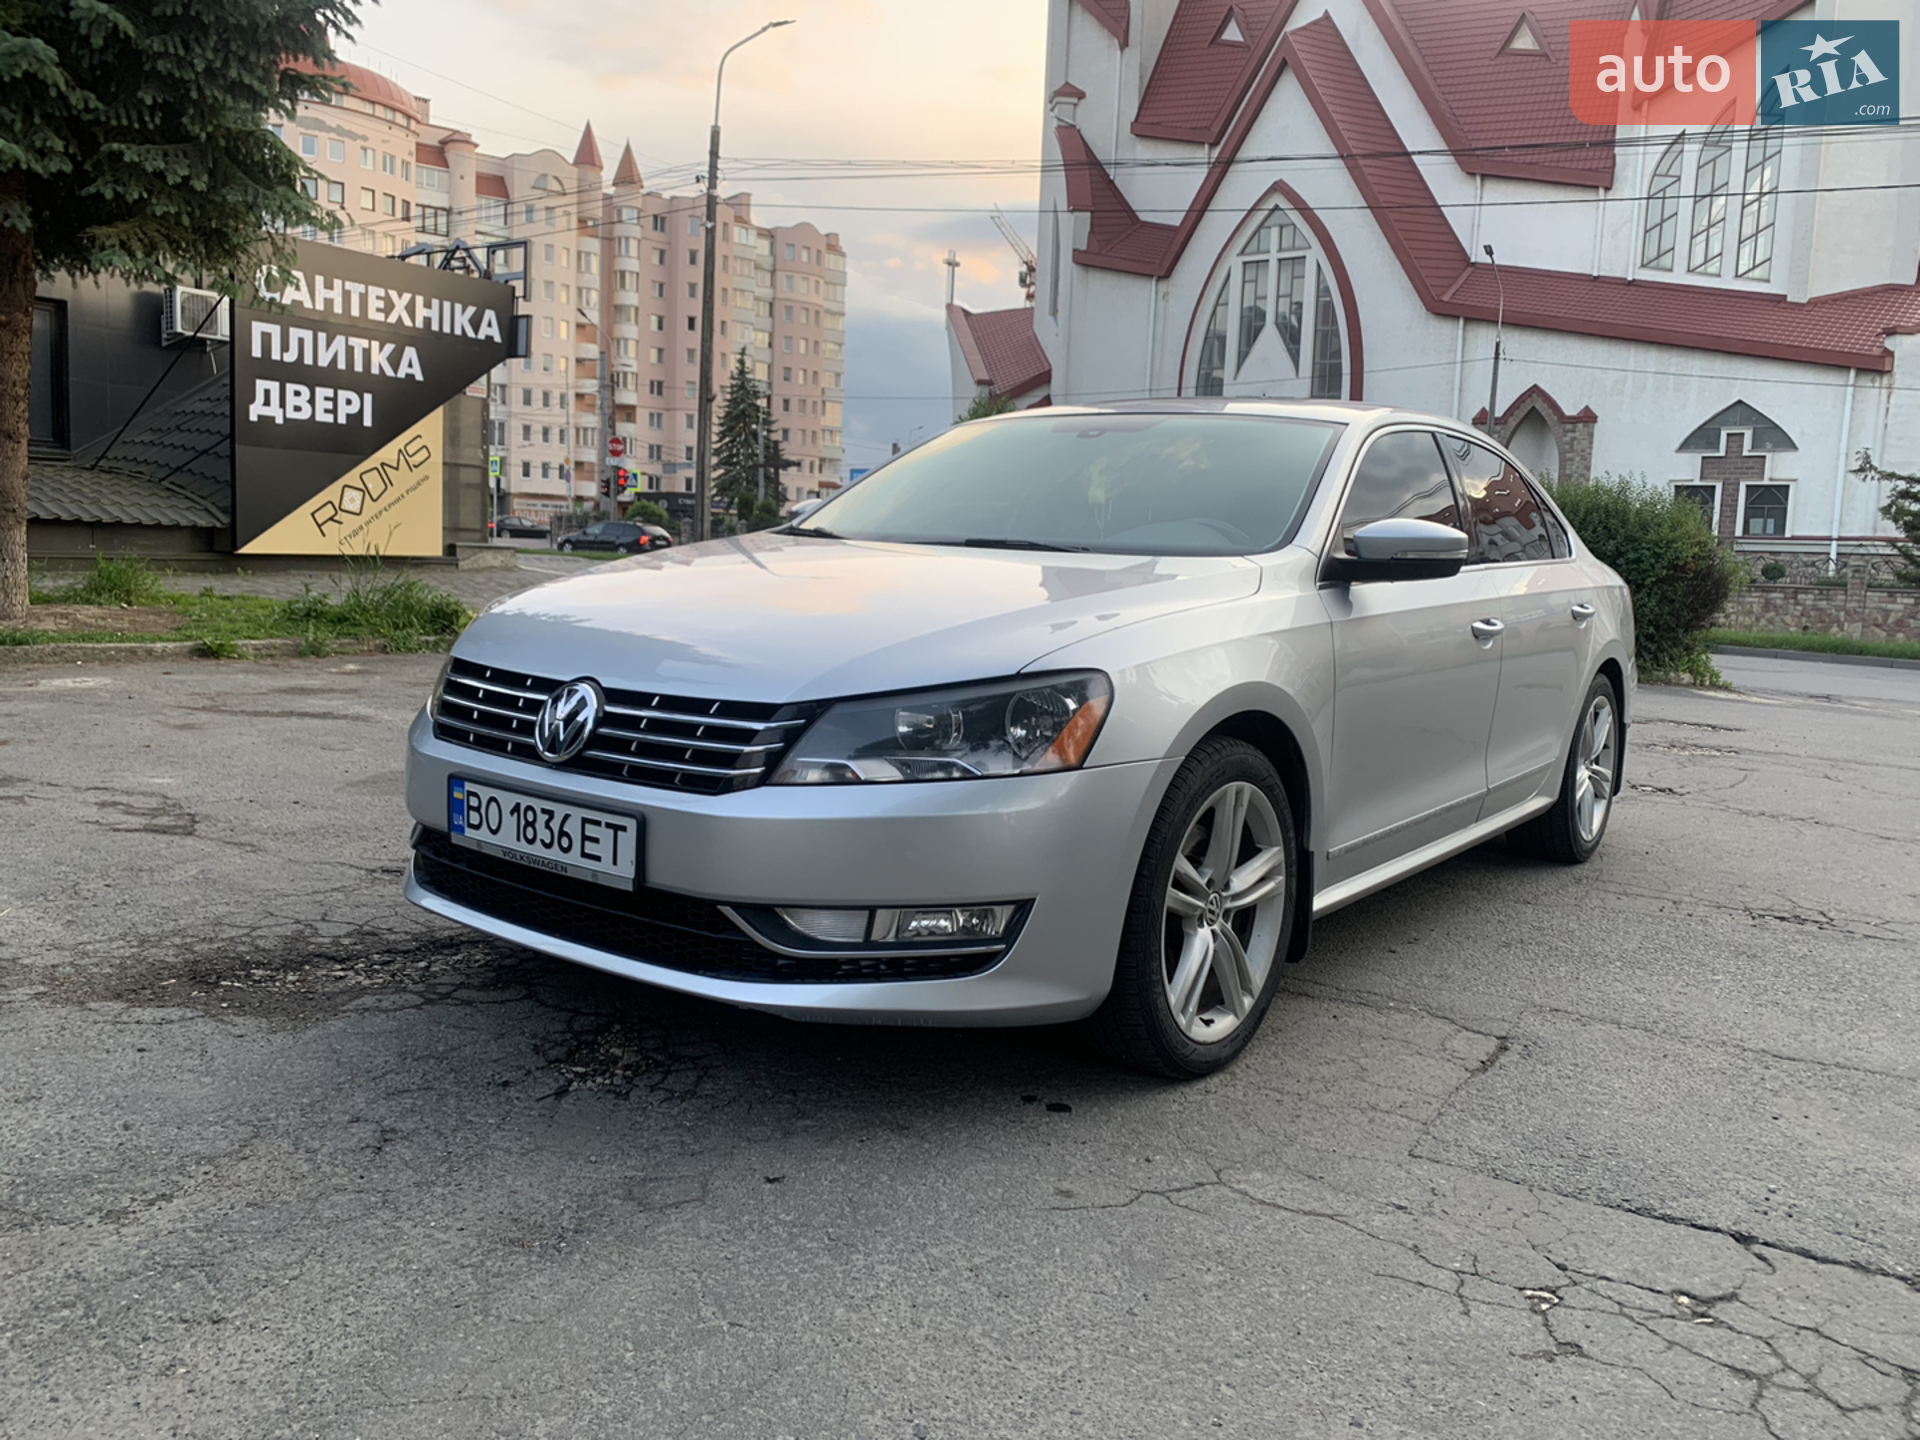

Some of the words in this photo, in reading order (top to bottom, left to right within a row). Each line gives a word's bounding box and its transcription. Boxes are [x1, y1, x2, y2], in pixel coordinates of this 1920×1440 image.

[255, 264, 502, 343] САНТЕХНІКА
[250, 320, 425, 382] ПЛИТКА
[249, 378, 373, 427] ДВЕРІ
[608, 442, 625, 451] STOP
[310, 434, 432, 538] ROOMS
[453, 813, 464, 826] UA
[466, 789, 503, 836] BO
[509, 802, 573, 855] 1836
[580, 816, 628, 866] ET
[500, 849, 568, 875] VOLKSWAGEN
